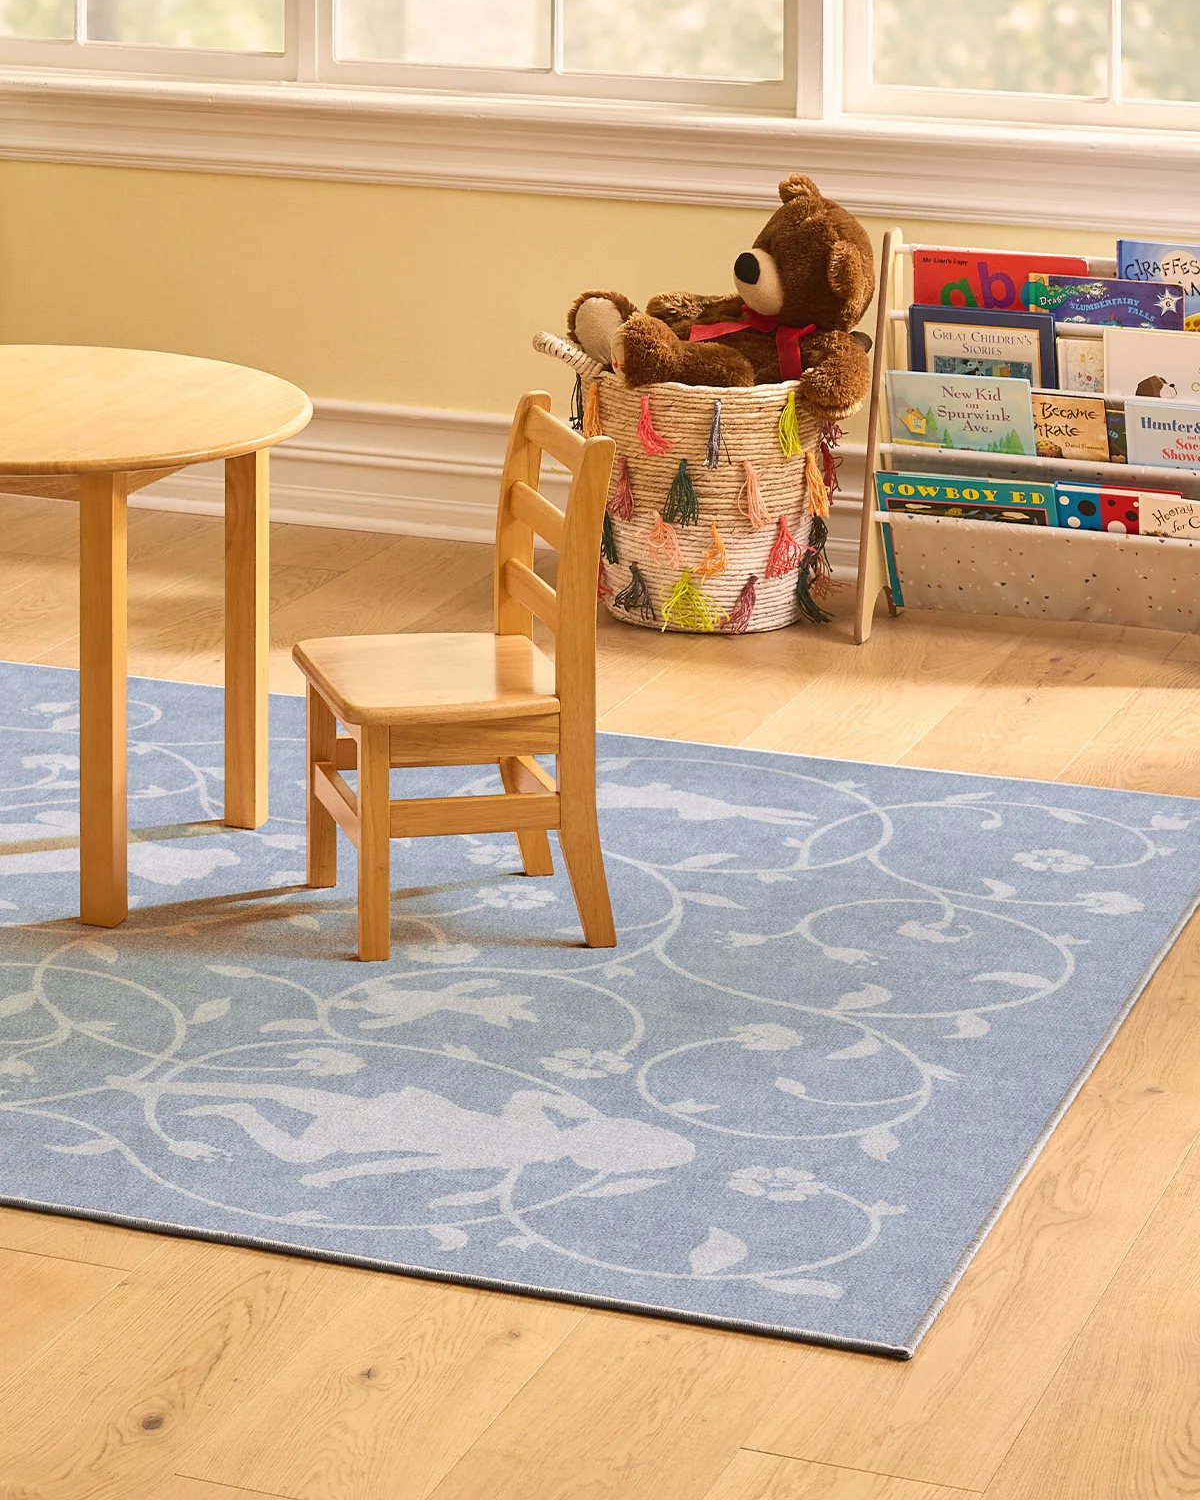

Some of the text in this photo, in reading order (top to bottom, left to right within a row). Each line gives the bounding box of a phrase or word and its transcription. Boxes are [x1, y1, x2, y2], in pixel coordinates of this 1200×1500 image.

[933, 257, 952, 265] Lion's
[1124, 257, 1200, 281] GIRAFFES
[940, 261, 1029, 309] ab
[1039, 293, 1067, 306] Dragon
[1070, 297, 1141, 312] SLUMBERFAIRY
[1165, 300, 1171, 308] 6
[1127, 306, 1156, 323] FALLS
[932, 328, 1033, 346] GREAT CHILDREN'S
[962, 342, 1003, 356] STORIES
[940, 385, 1003, 402] New Kid
[937, 405, 1011, 422] Spurwink
[965, 402, 979, 410] on
[1040, 401, 1102, 421] Became
[962, 419, 993, 433] Ave.
[1140, 416, 1193, 433] Hunter
[1175, 438, 1200, 450] Soc
[882, 482, 1046, 505] COWBOY ED
[1151, 503, 1194, 527] Hooray
[1171, 519, 1188, 534] for
